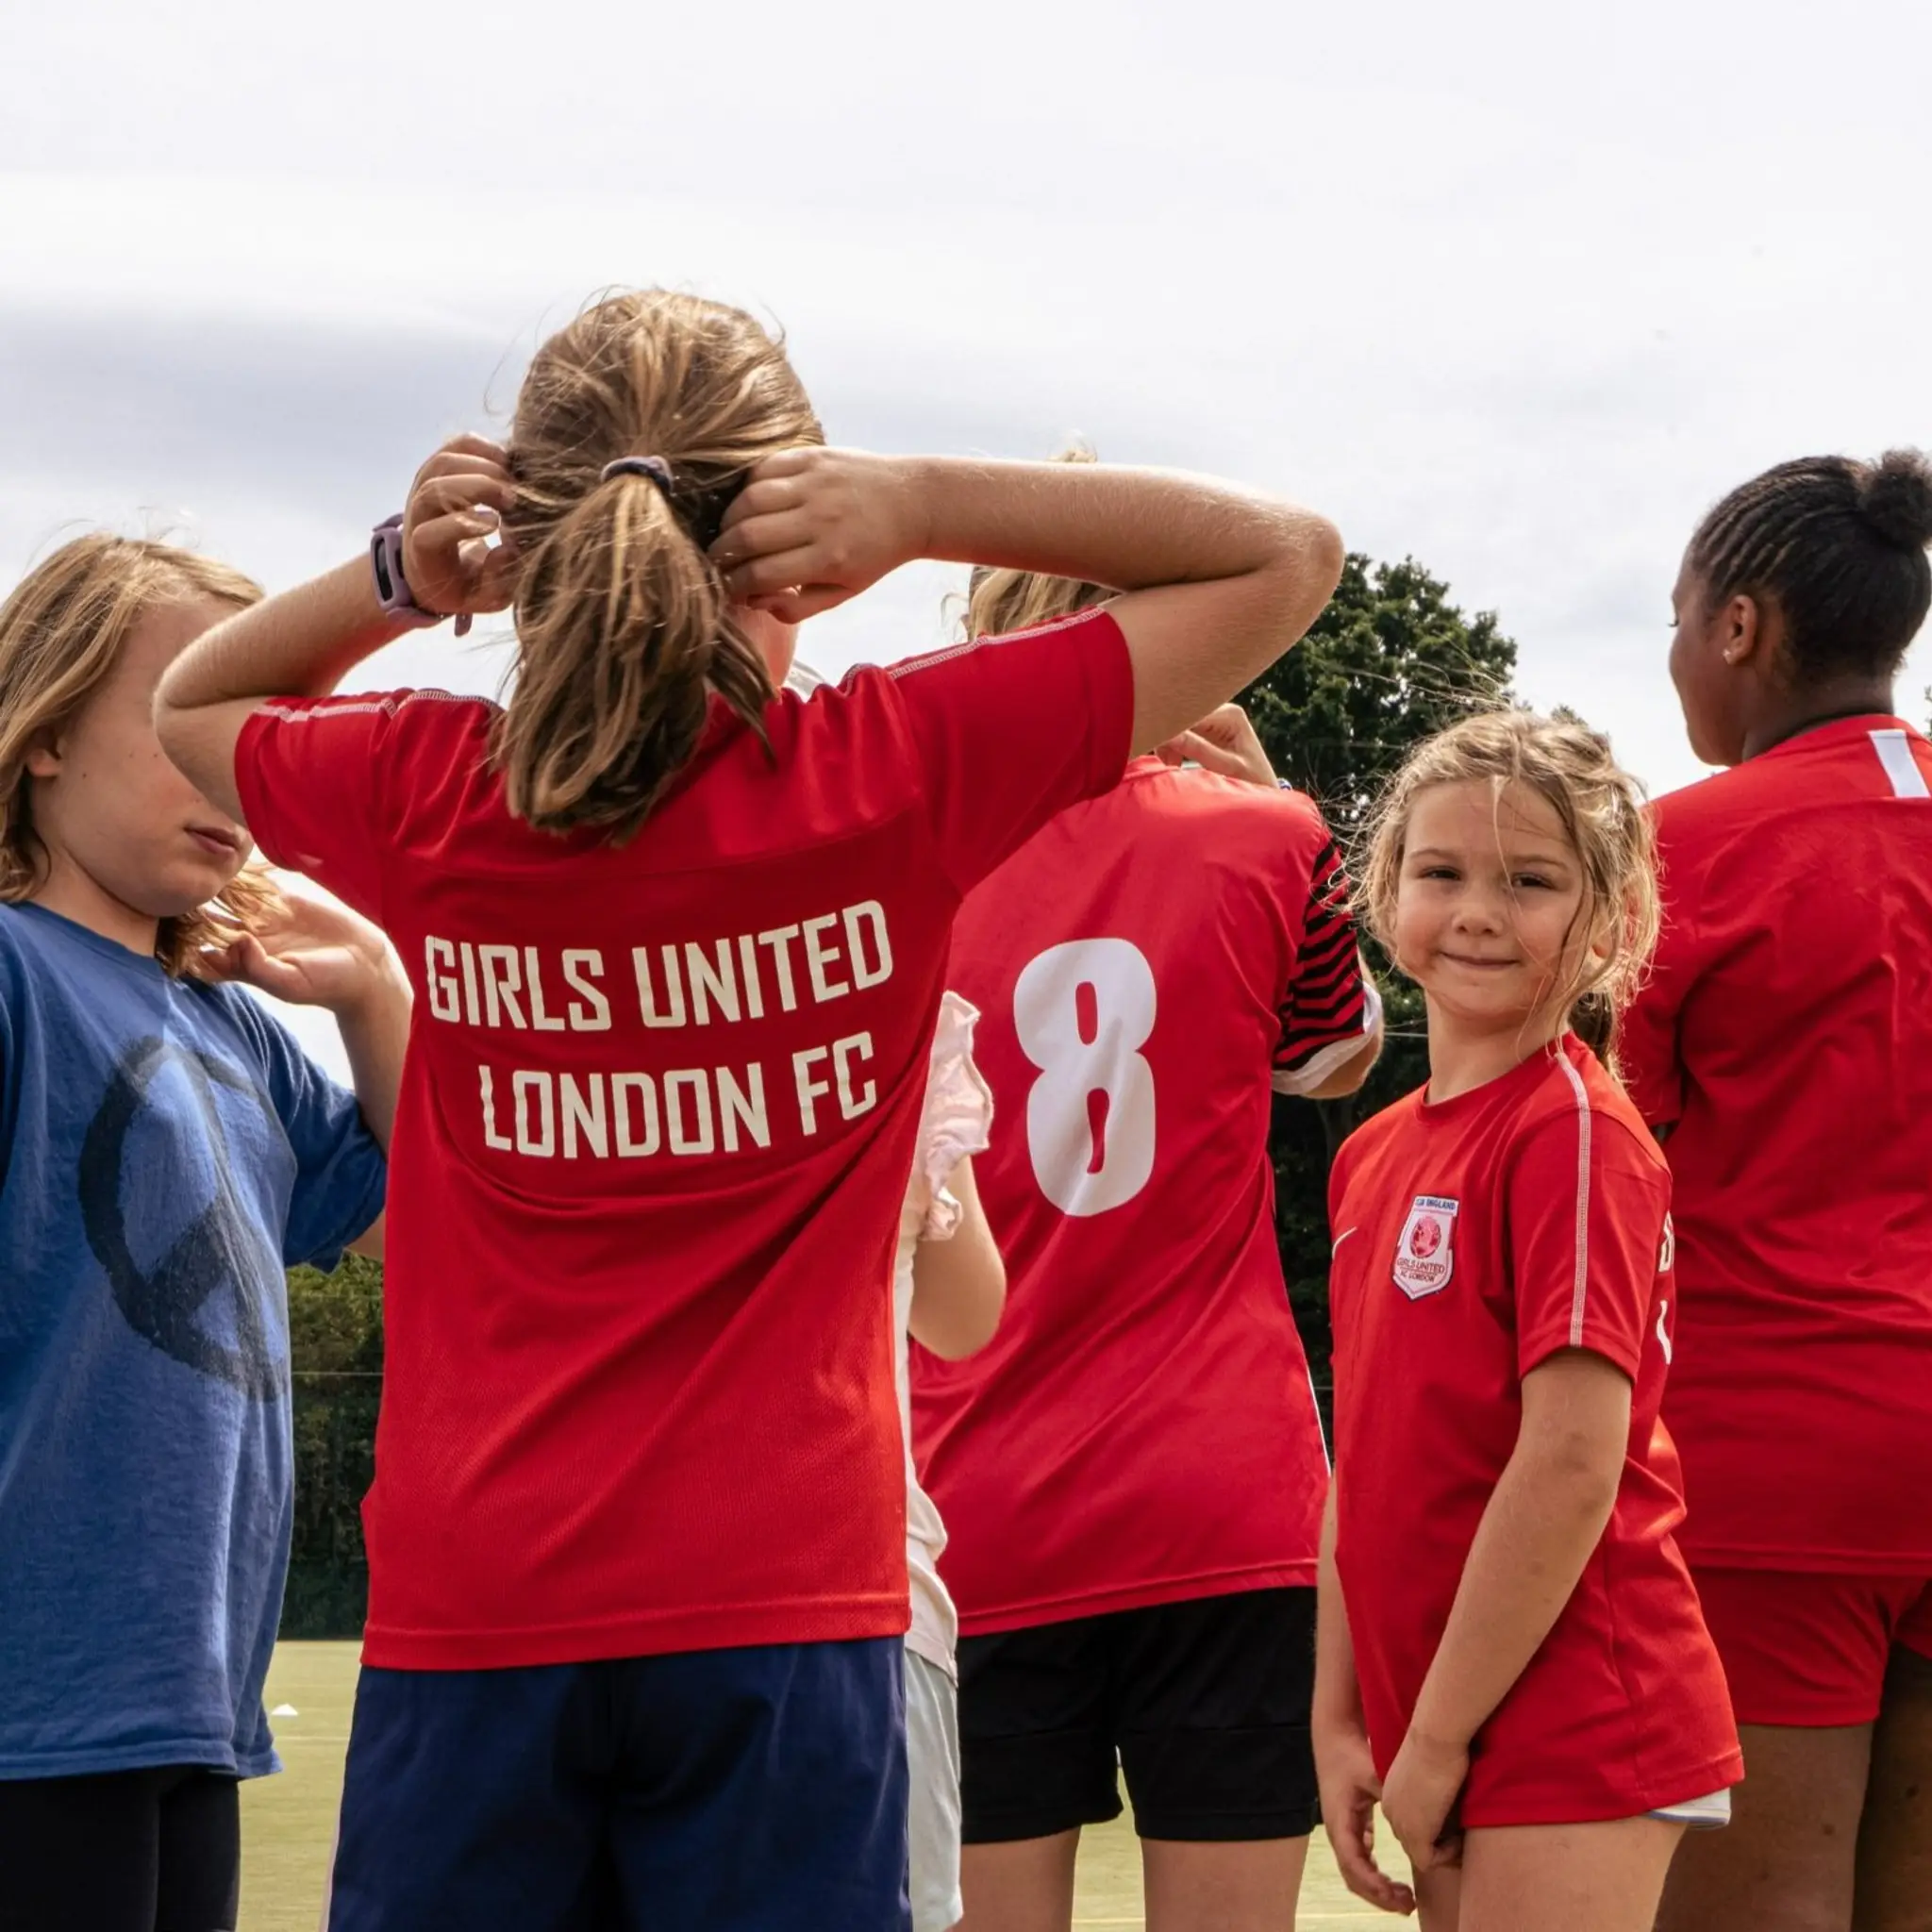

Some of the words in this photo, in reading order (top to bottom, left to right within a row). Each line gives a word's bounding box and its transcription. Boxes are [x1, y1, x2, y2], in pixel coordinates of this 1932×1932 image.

[425, 935, 612, 1031] GIRLS
[631, 899, 894, 1029] UNITED
[478, 1061, 772, 1158] LONDON
[791, 1030, 877, 1136] FC
[1013, 938, 1158, 1217] 8
[1397, 1257, 1415, 1268] GIRLS
[1416, 1261, 1445, 1274] UNITED
[1426, 1198, 1456, 1210] ENGLAND
